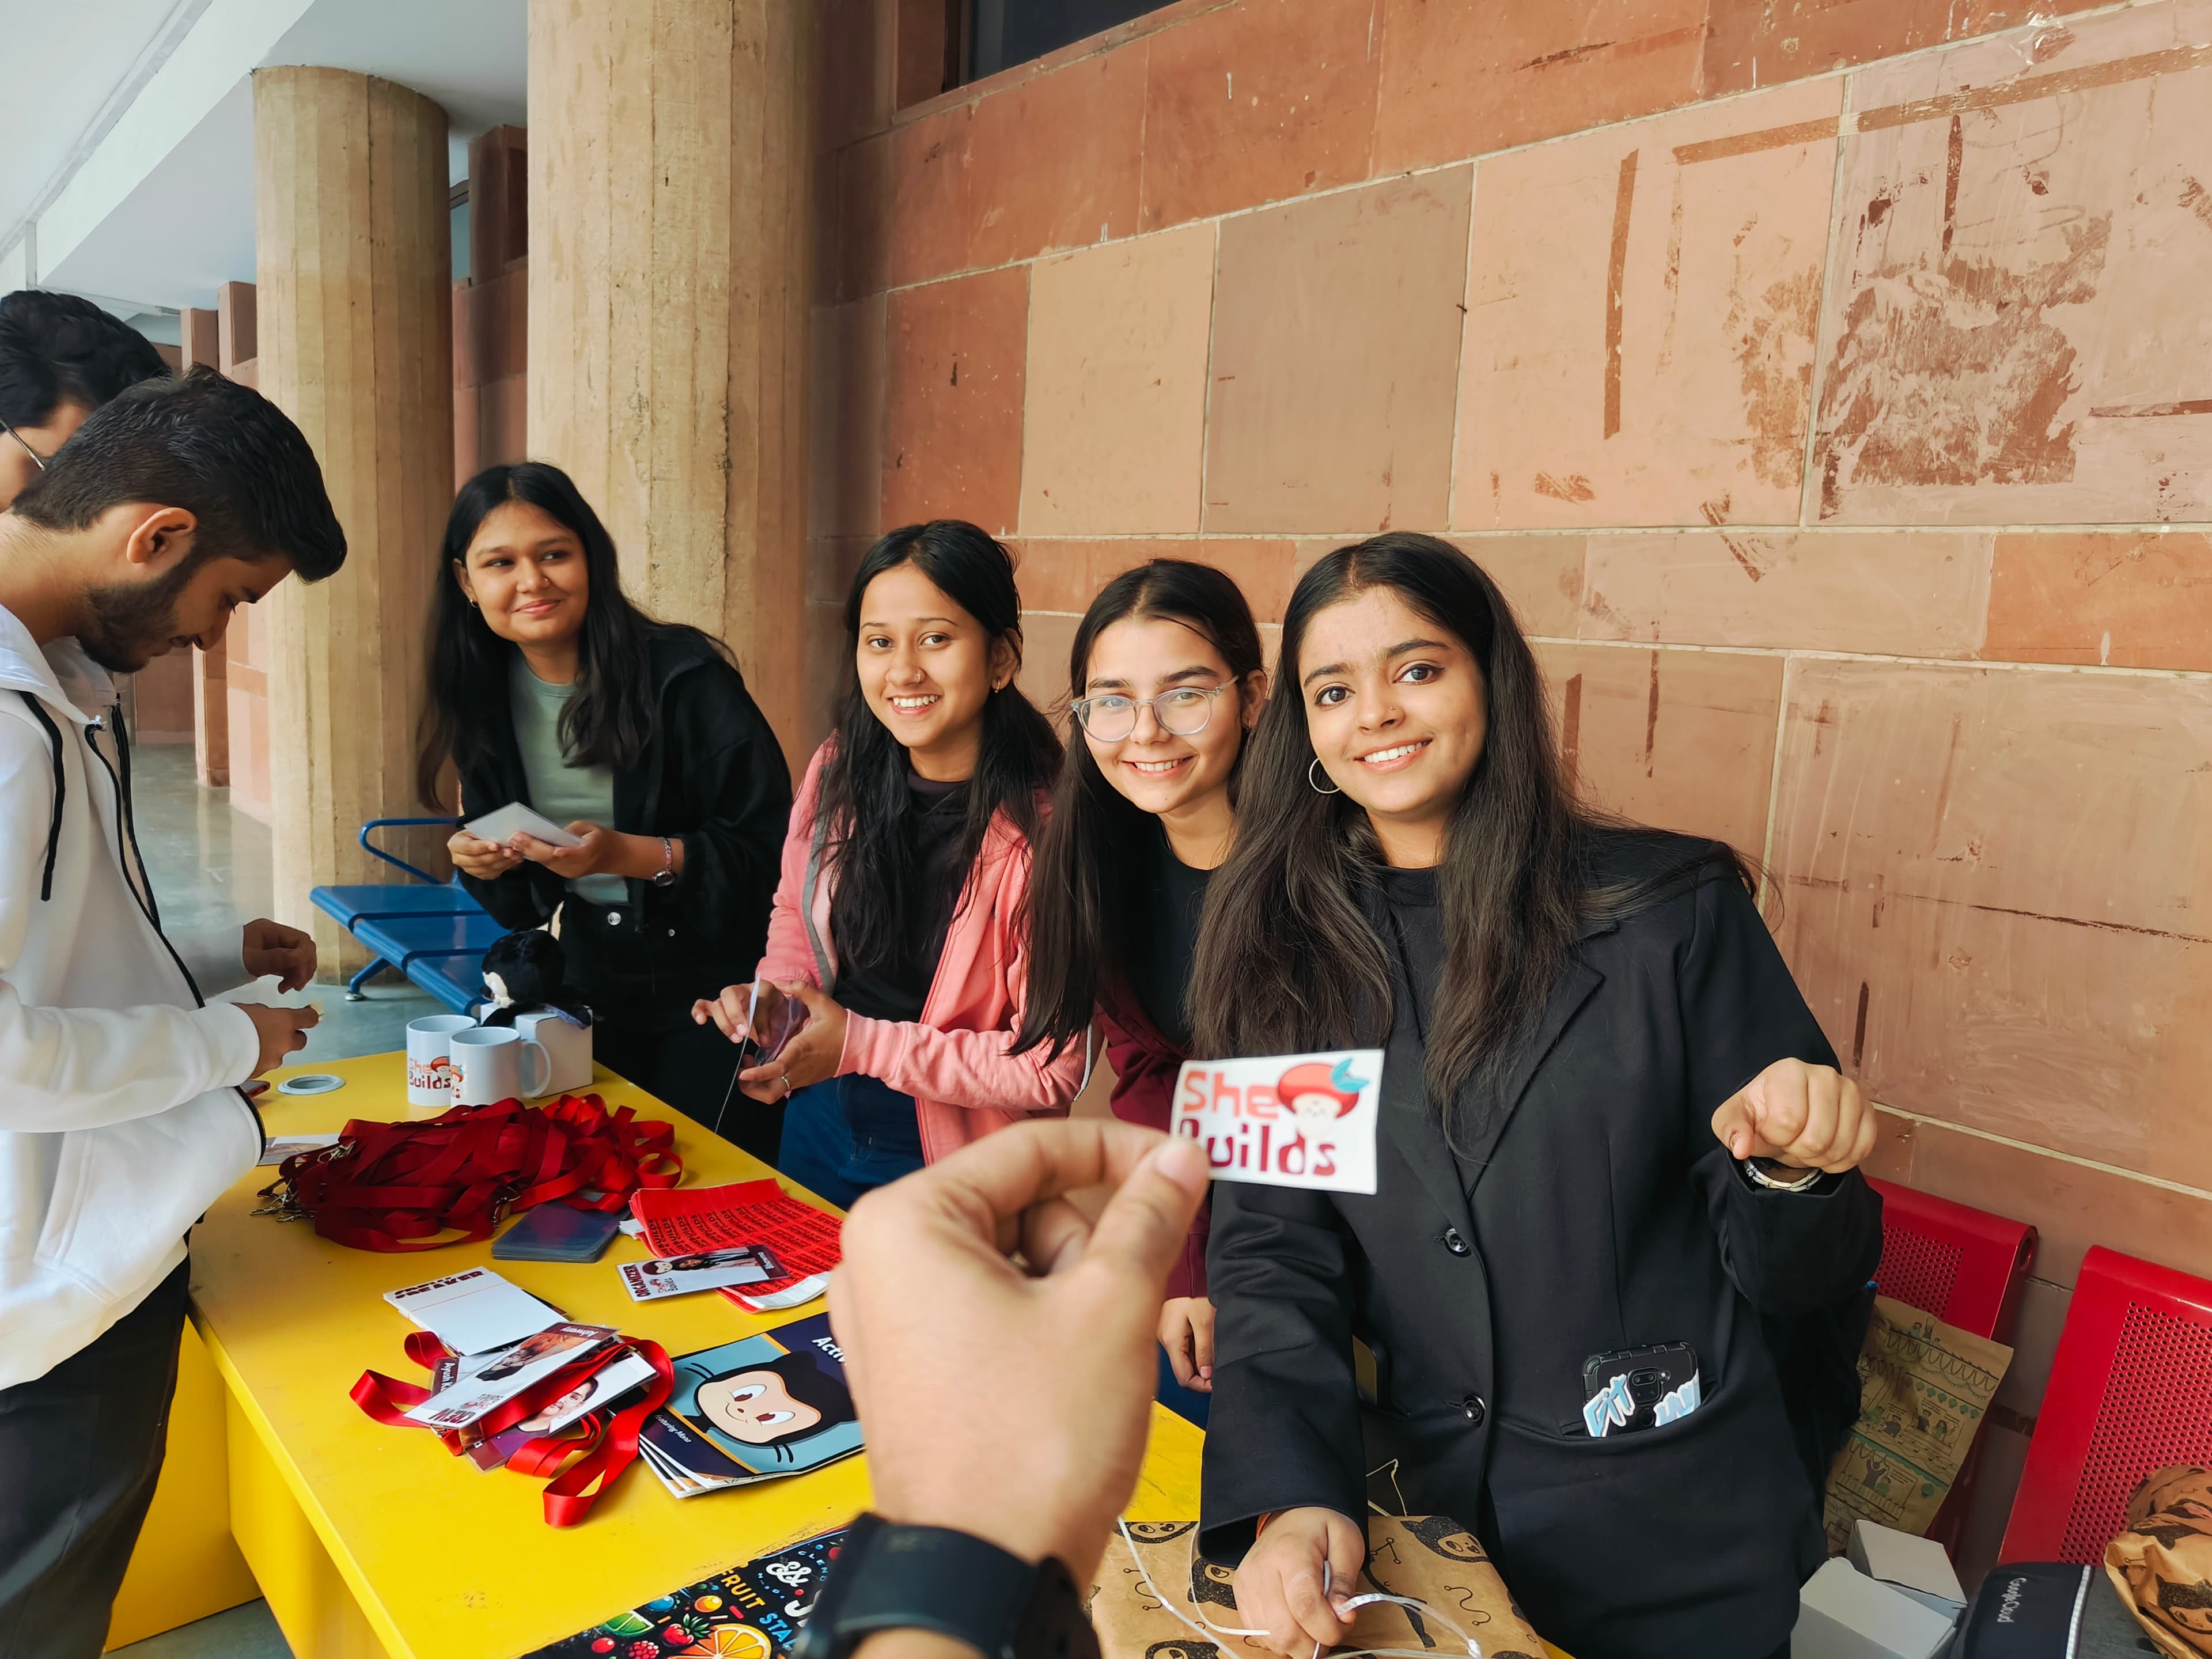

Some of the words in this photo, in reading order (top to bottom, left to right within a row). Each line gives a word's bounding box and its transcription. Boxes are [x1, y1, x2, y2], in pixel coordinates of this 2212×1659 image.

[409, 1058, 433, 1074] She
[409, 1071, 451, 1089] Builds
[1183, 1070, 1280, 1119] She
[623, 1264, 651, 1297] ORGANIZER
[440, 1362, 456, 1382] Ayush
[427, 1408, 476, 1425] CREW
[654, 1414, 678, 1433] Featuring
[2001, 1577, 2028, 1602] Google
[1997, 1601, 2020, 1623] Cloud
